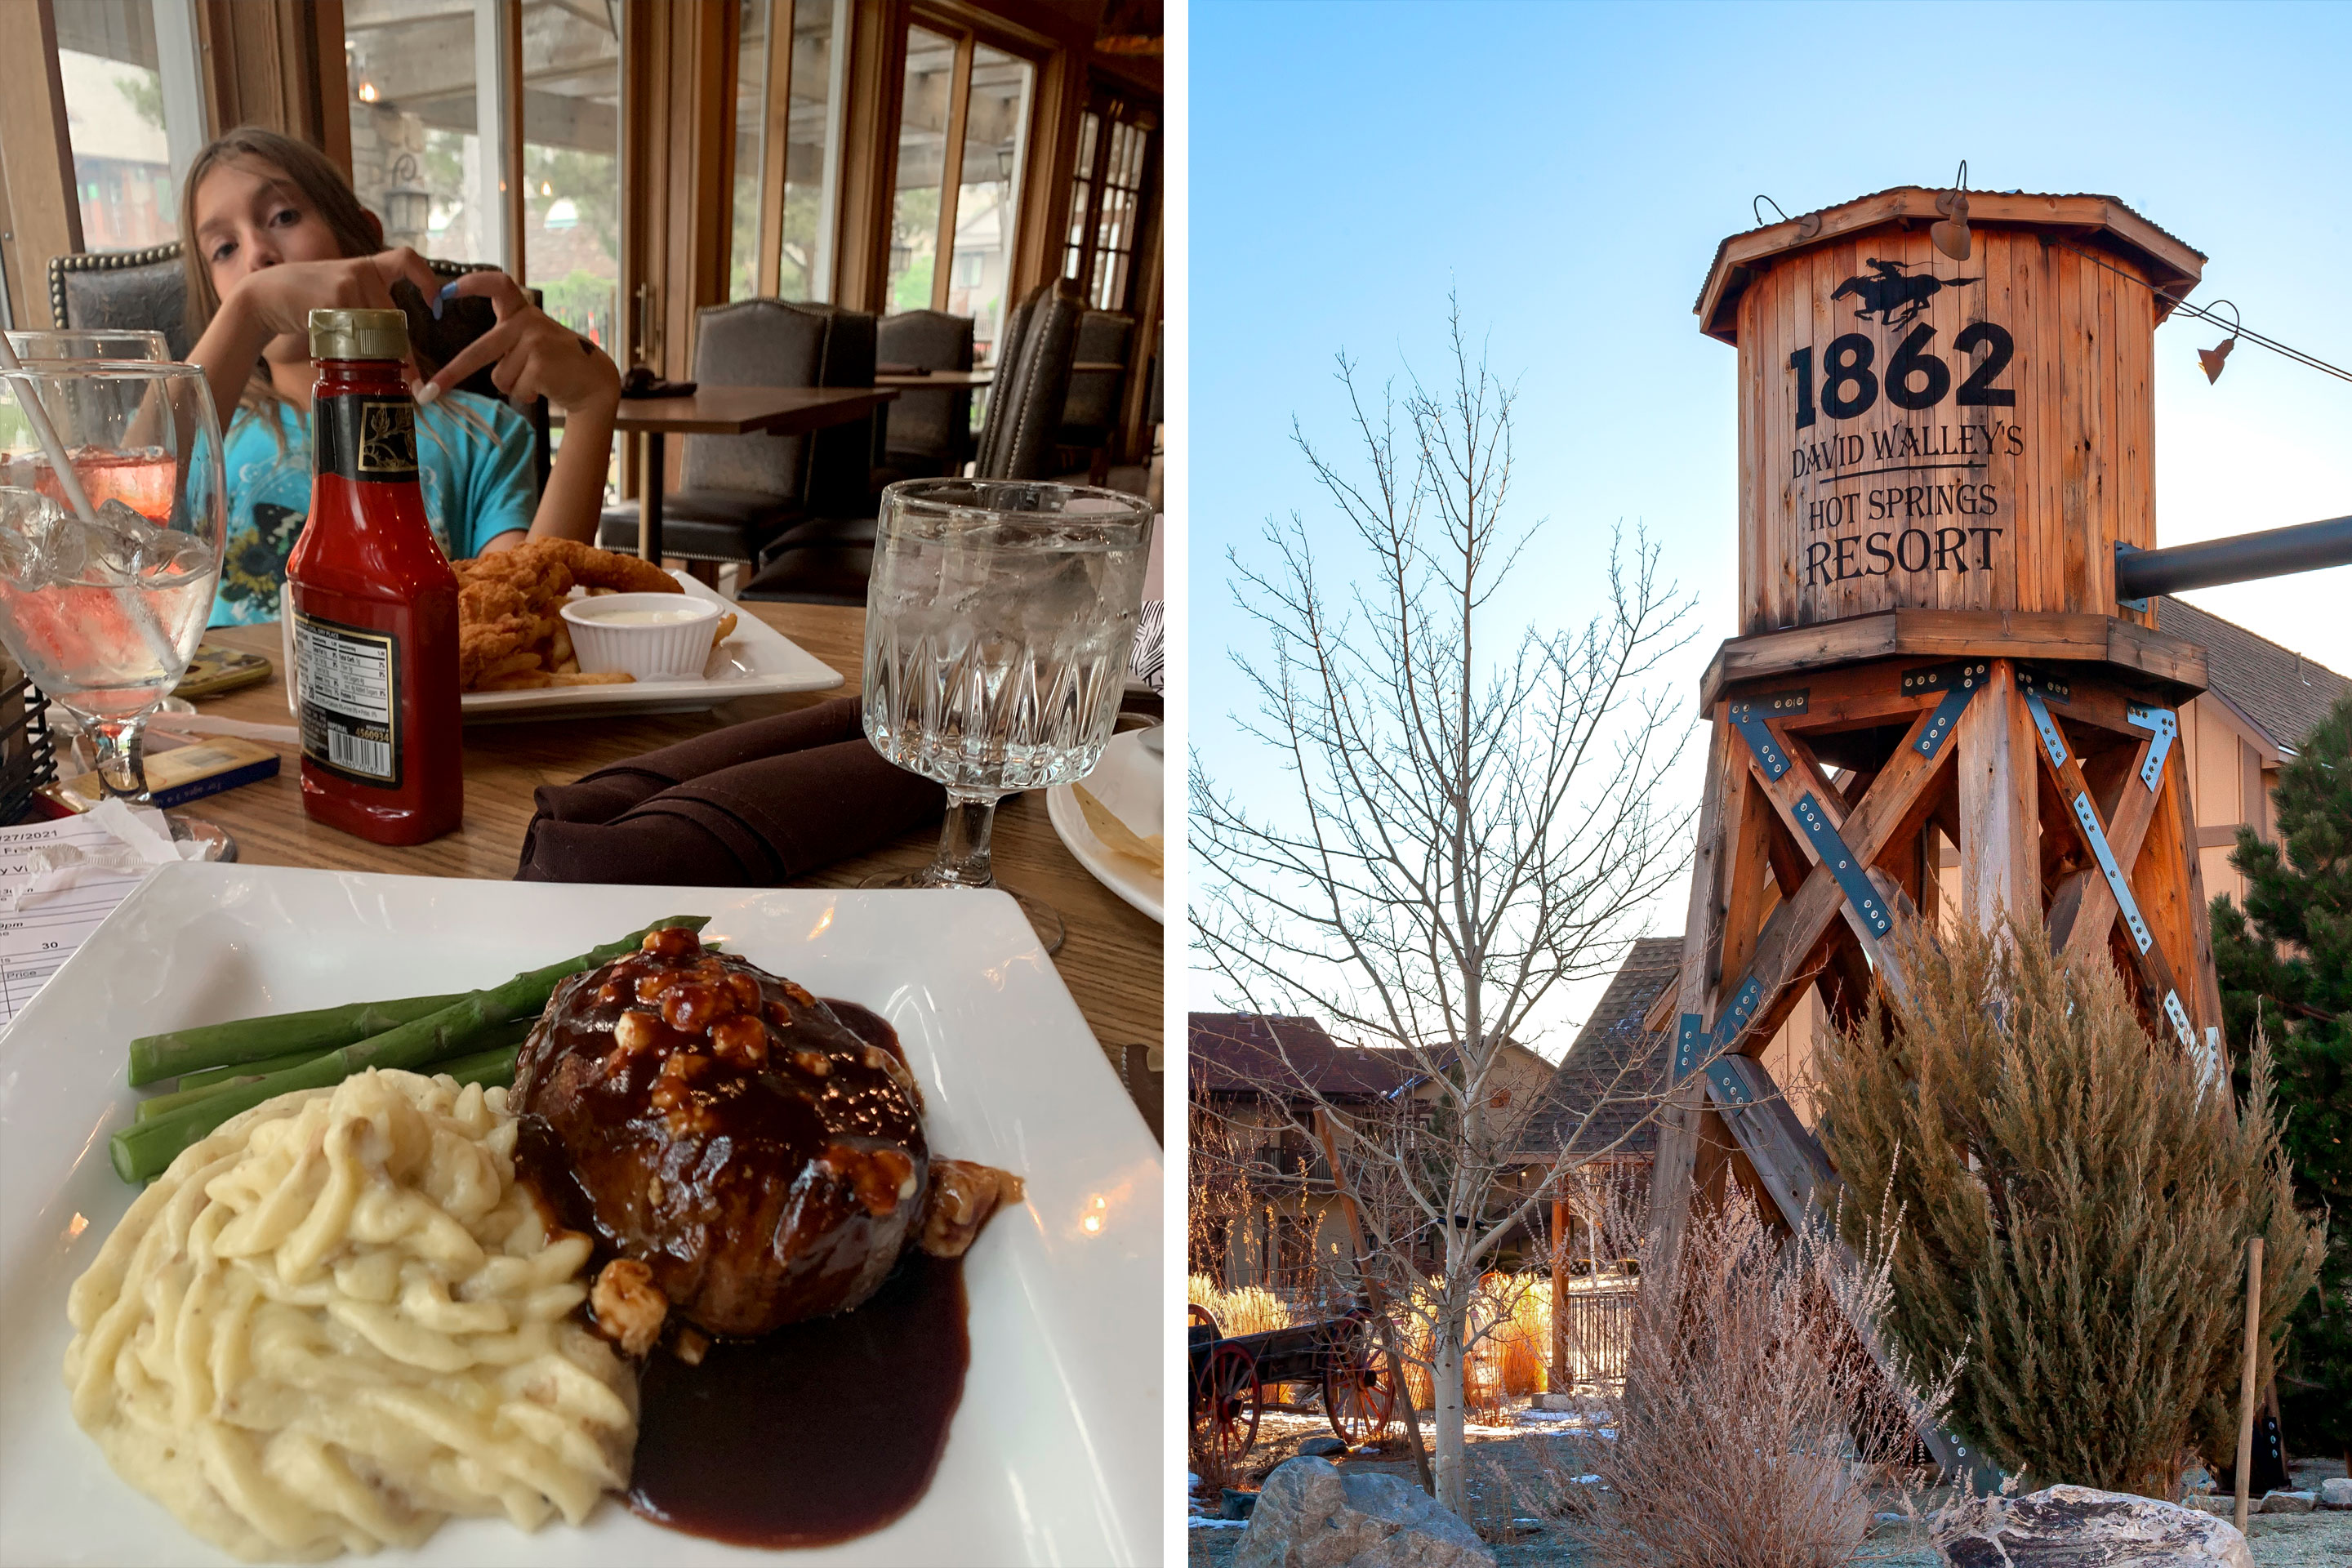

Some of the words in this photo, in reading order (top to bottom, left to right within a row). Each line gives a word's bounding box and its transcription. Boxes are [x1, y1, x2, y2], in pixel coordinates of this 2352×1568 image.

[1790, 321, 2016, 431] 1862
[1792, 433, 1864, 479] DAVID
[1871, 420, 2024, 460] WALLEY'S
[1809, 493, 1860, 532] HOT
[1868, 484, 1998, 520] SPRINGS
[1806, 528, 2003, 587] RESORT
[326, 630, 339, 639] PLACE
[355, 728, 390, 742] 4560934
[42, 941, 58, 950] 30
[7, 970, 37, 979] Price
